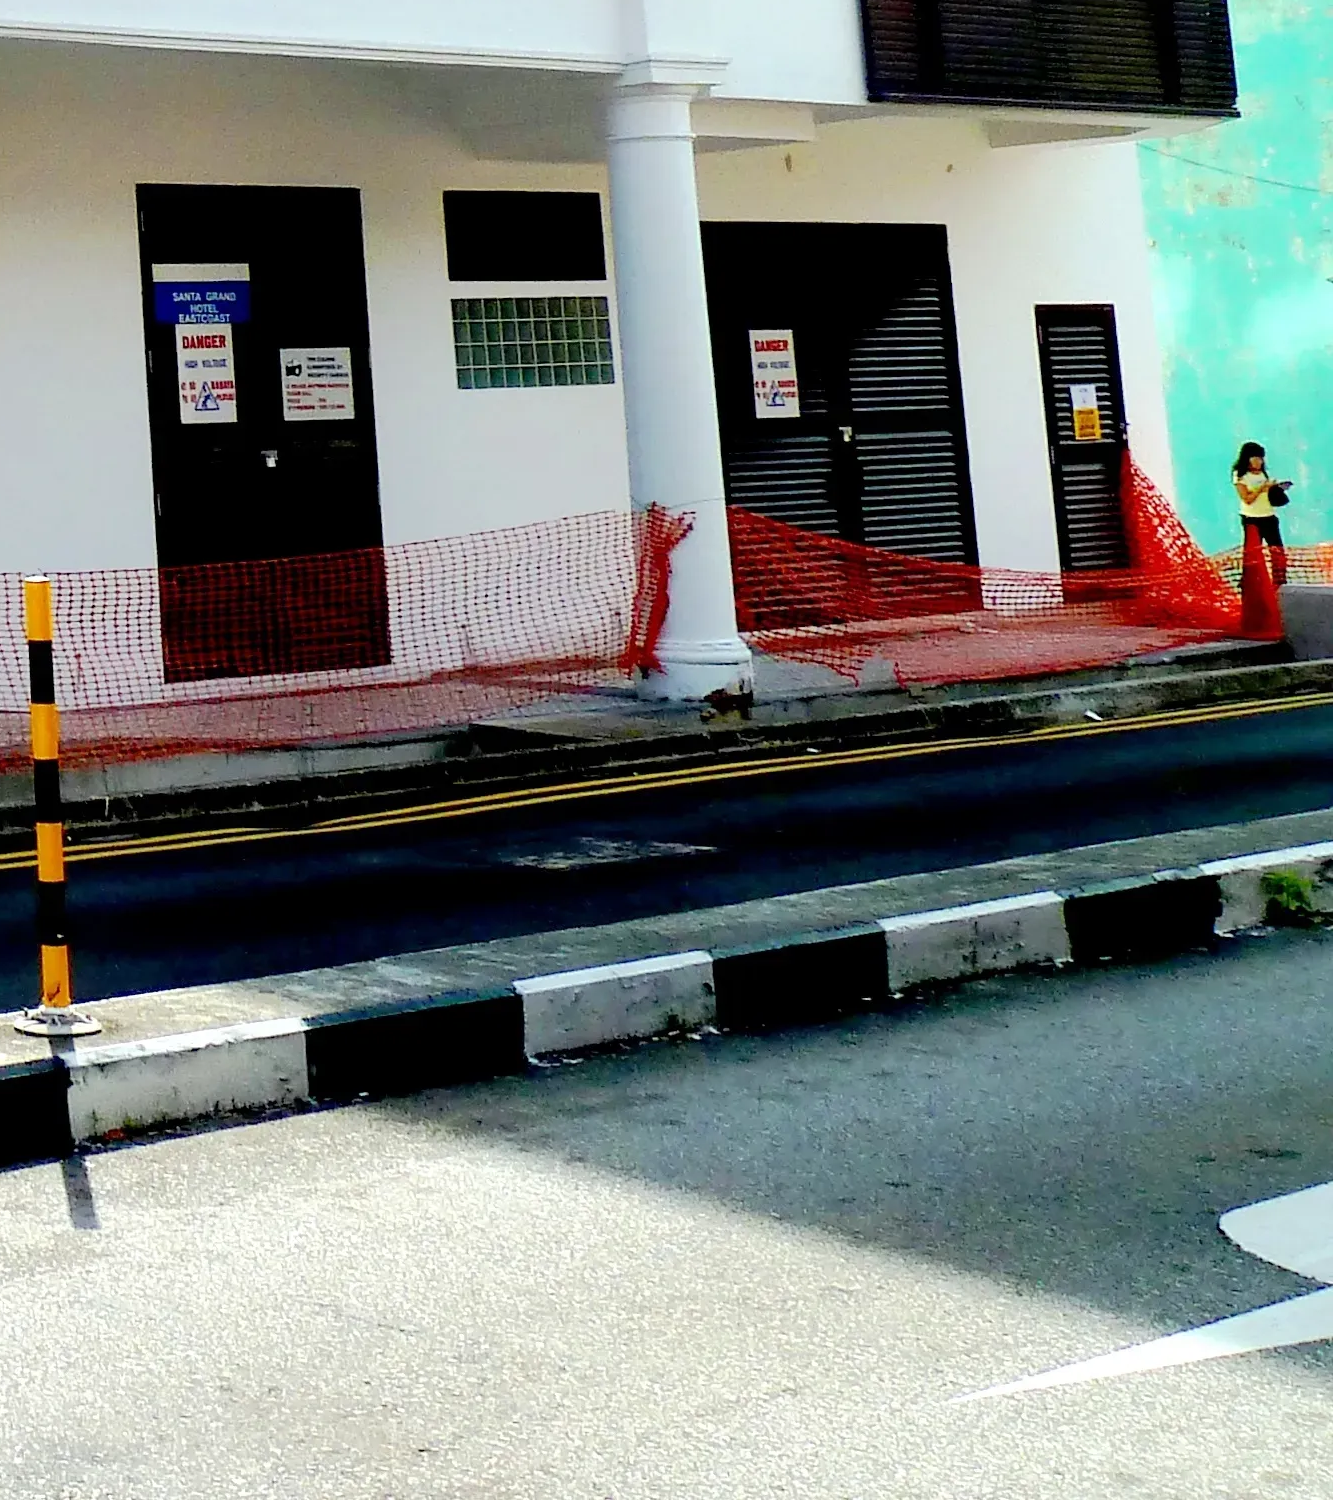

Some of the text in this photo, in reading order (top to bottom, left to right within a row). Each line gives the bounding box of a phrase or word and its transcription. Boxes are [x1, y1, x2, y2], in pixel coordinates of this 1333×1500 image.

[172, 292, 236, 302] SANTA GRAND
[190, 304, 219, 313] HOTEL
[178, 314, 230, 323] EASTCOAST
[182, 334, 227, 349] DANGER
